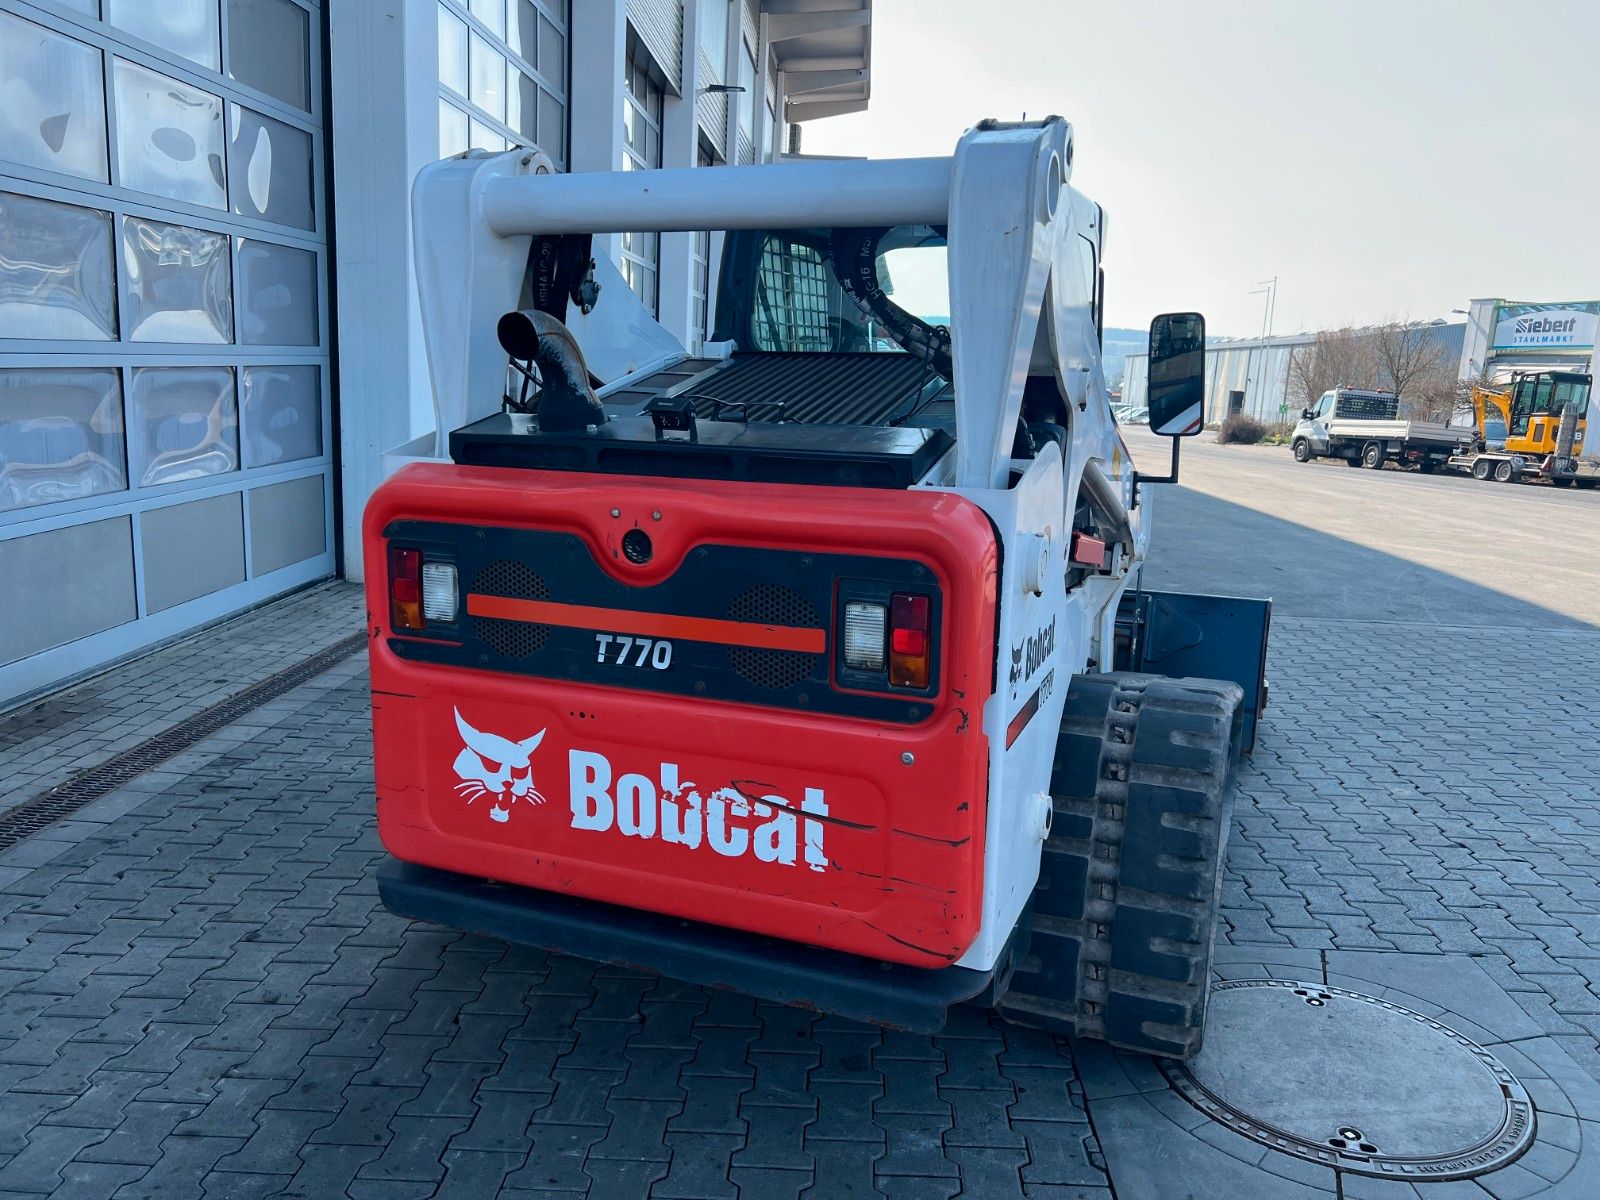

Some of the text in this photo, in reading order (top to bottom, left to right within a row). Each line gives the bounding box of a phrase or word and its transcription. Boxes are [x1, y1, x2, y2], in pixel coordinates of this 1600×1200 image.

[1513, 335, 1574, 343] STAHLMARKT
[1515, 317, 1577, 333] Siebert
[596, 633, 673, 670] T770
[1025, 613, 1057, 683] Bobcat
[569, 749, 830, 873] Bobcat
